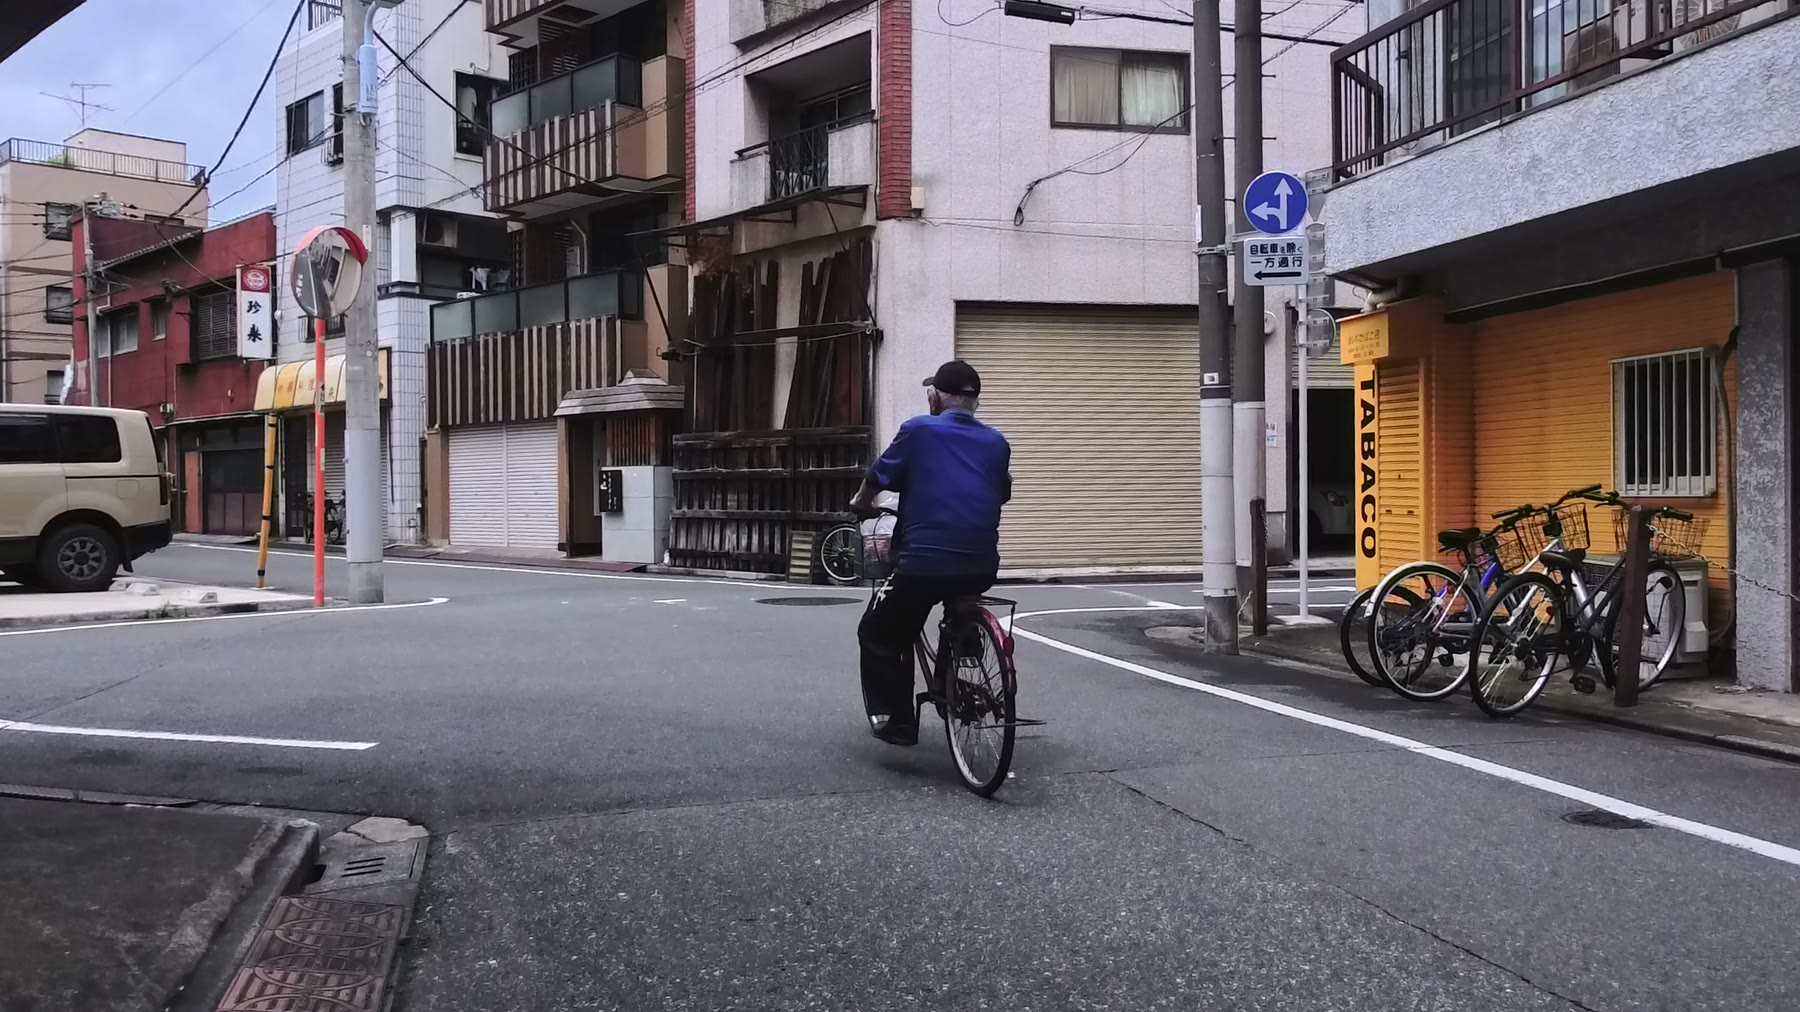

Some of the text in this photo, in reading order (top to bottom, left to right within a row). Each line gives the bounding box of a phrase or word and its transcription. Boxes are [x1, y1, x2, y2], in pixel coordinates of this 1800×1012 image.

[1250, 242, 1303, 255] 自転車を除く
[1250, 256, 1303, 268] 一方通行
[1361, 369, 1376, 559] TABACO
